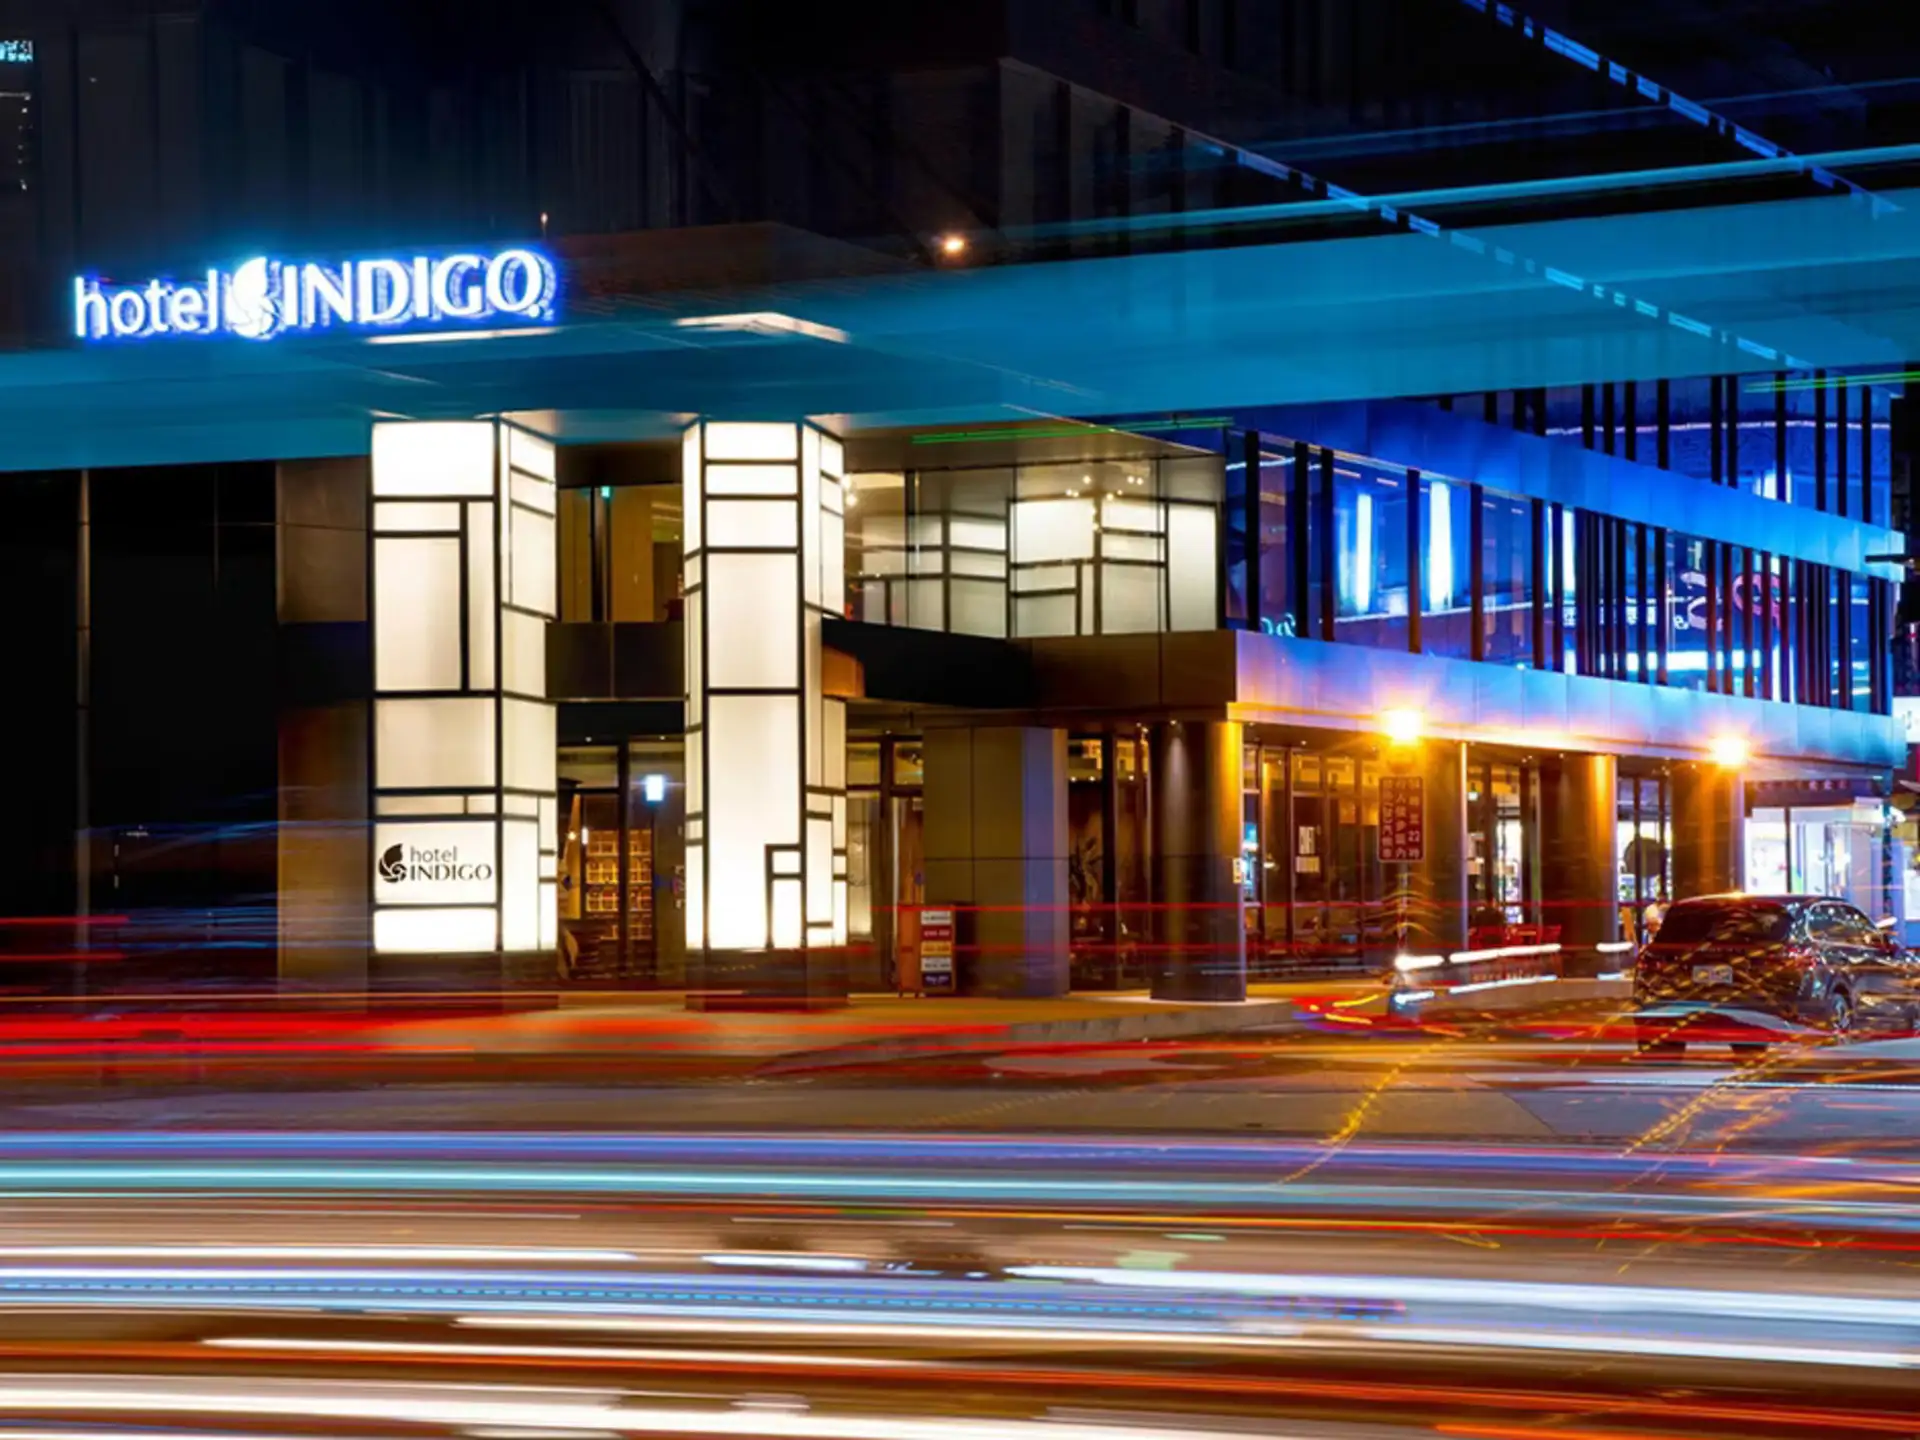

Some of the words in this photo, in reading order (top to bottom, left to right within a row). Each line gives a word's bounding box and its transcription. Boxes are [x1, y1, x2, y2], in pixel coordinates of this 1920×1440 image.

[75, 268, 218, 337] hotel
[283, 250, 545, 326] INDIGO
[410, 845, 457, 862] hotel
[410, 864, 492, 881] INDIGO
